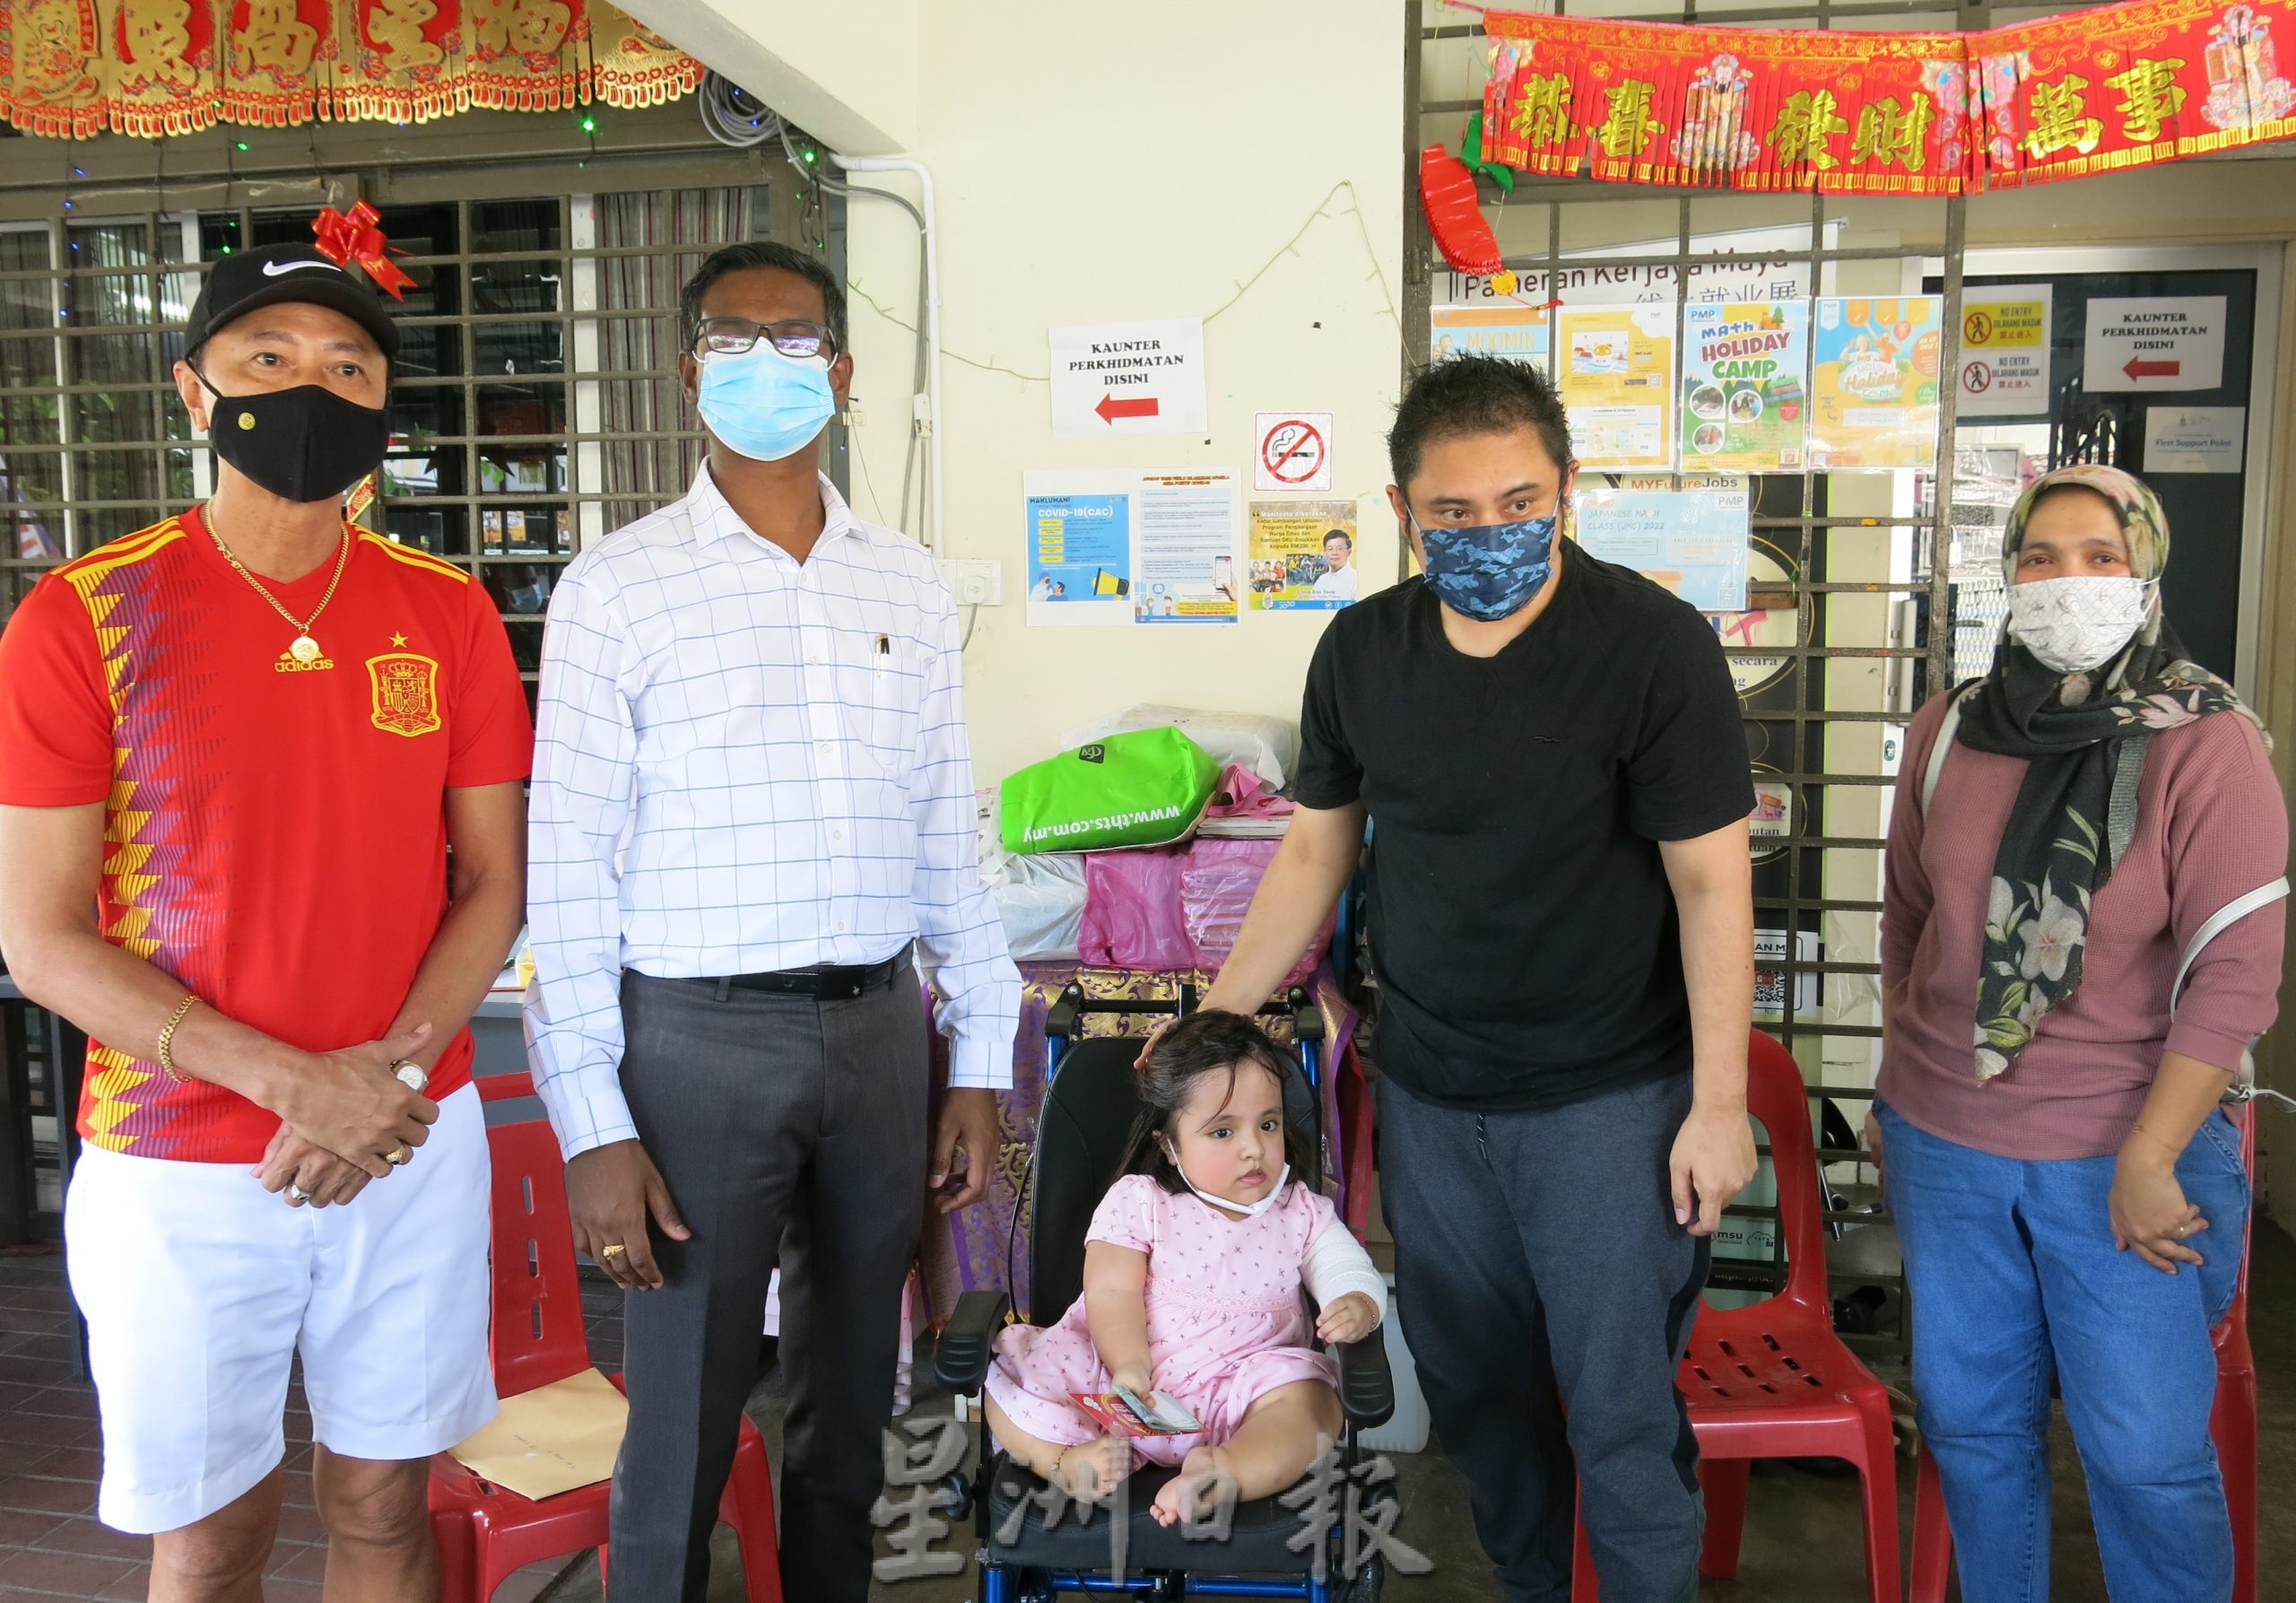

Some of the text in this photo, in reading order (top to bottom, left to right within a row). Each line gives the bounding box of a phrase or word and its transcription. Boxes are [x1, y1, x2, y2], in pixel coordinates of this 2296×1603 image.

[2017, 57, 2188, 160] 萬事
[1465, 269, 1585, 300] Paeran
[1691, 310, 1715, 319] PMP
[2001, 307, 2032, 317] NO ENTRY
[2123, 312, 2187, 323] KAUNTER
[1994, 318, 2041, 328] DILARANG MASUK
[2102, 327, 2208, 336] PERKHIDMATAN
[1466, 330, 1535, 351] MOOMIN
[2134, 340, 2174, 350] DISINI
[1091, 339, 1161, 354] KAUNTER
[1700, 331, 1790, 362] HOLIDAY
[1068, 354, 1184, 371] PERKHIDMATAN
[1998, 357, 2031, 366] NO ENTRY
[1712, 360, 1778, 379] CAMP
[1992, 368, 2039, 378] DILARANG MASUK
[1103, 373, 1149, 386] DISINI
[2176, 439, 2207, 448] Support
[2210, 439, 2231, 447] Point
[1631, 477, 1738, 490] MYFuureJobs
[1718, 496, 1744, 506] PMP
[1038, 505, 1113, 518] COVID-19(CAC)
[1587, 510, 1659, 518] JAPANESE MAH
[1587, 522, 1665, 531] CLASS (JMC) 2022
[274, 658, 335, 673] adidas
[1732, 657, 1778, 666] secara
[1022, 804, 1180, 843] www.thts.com.my
